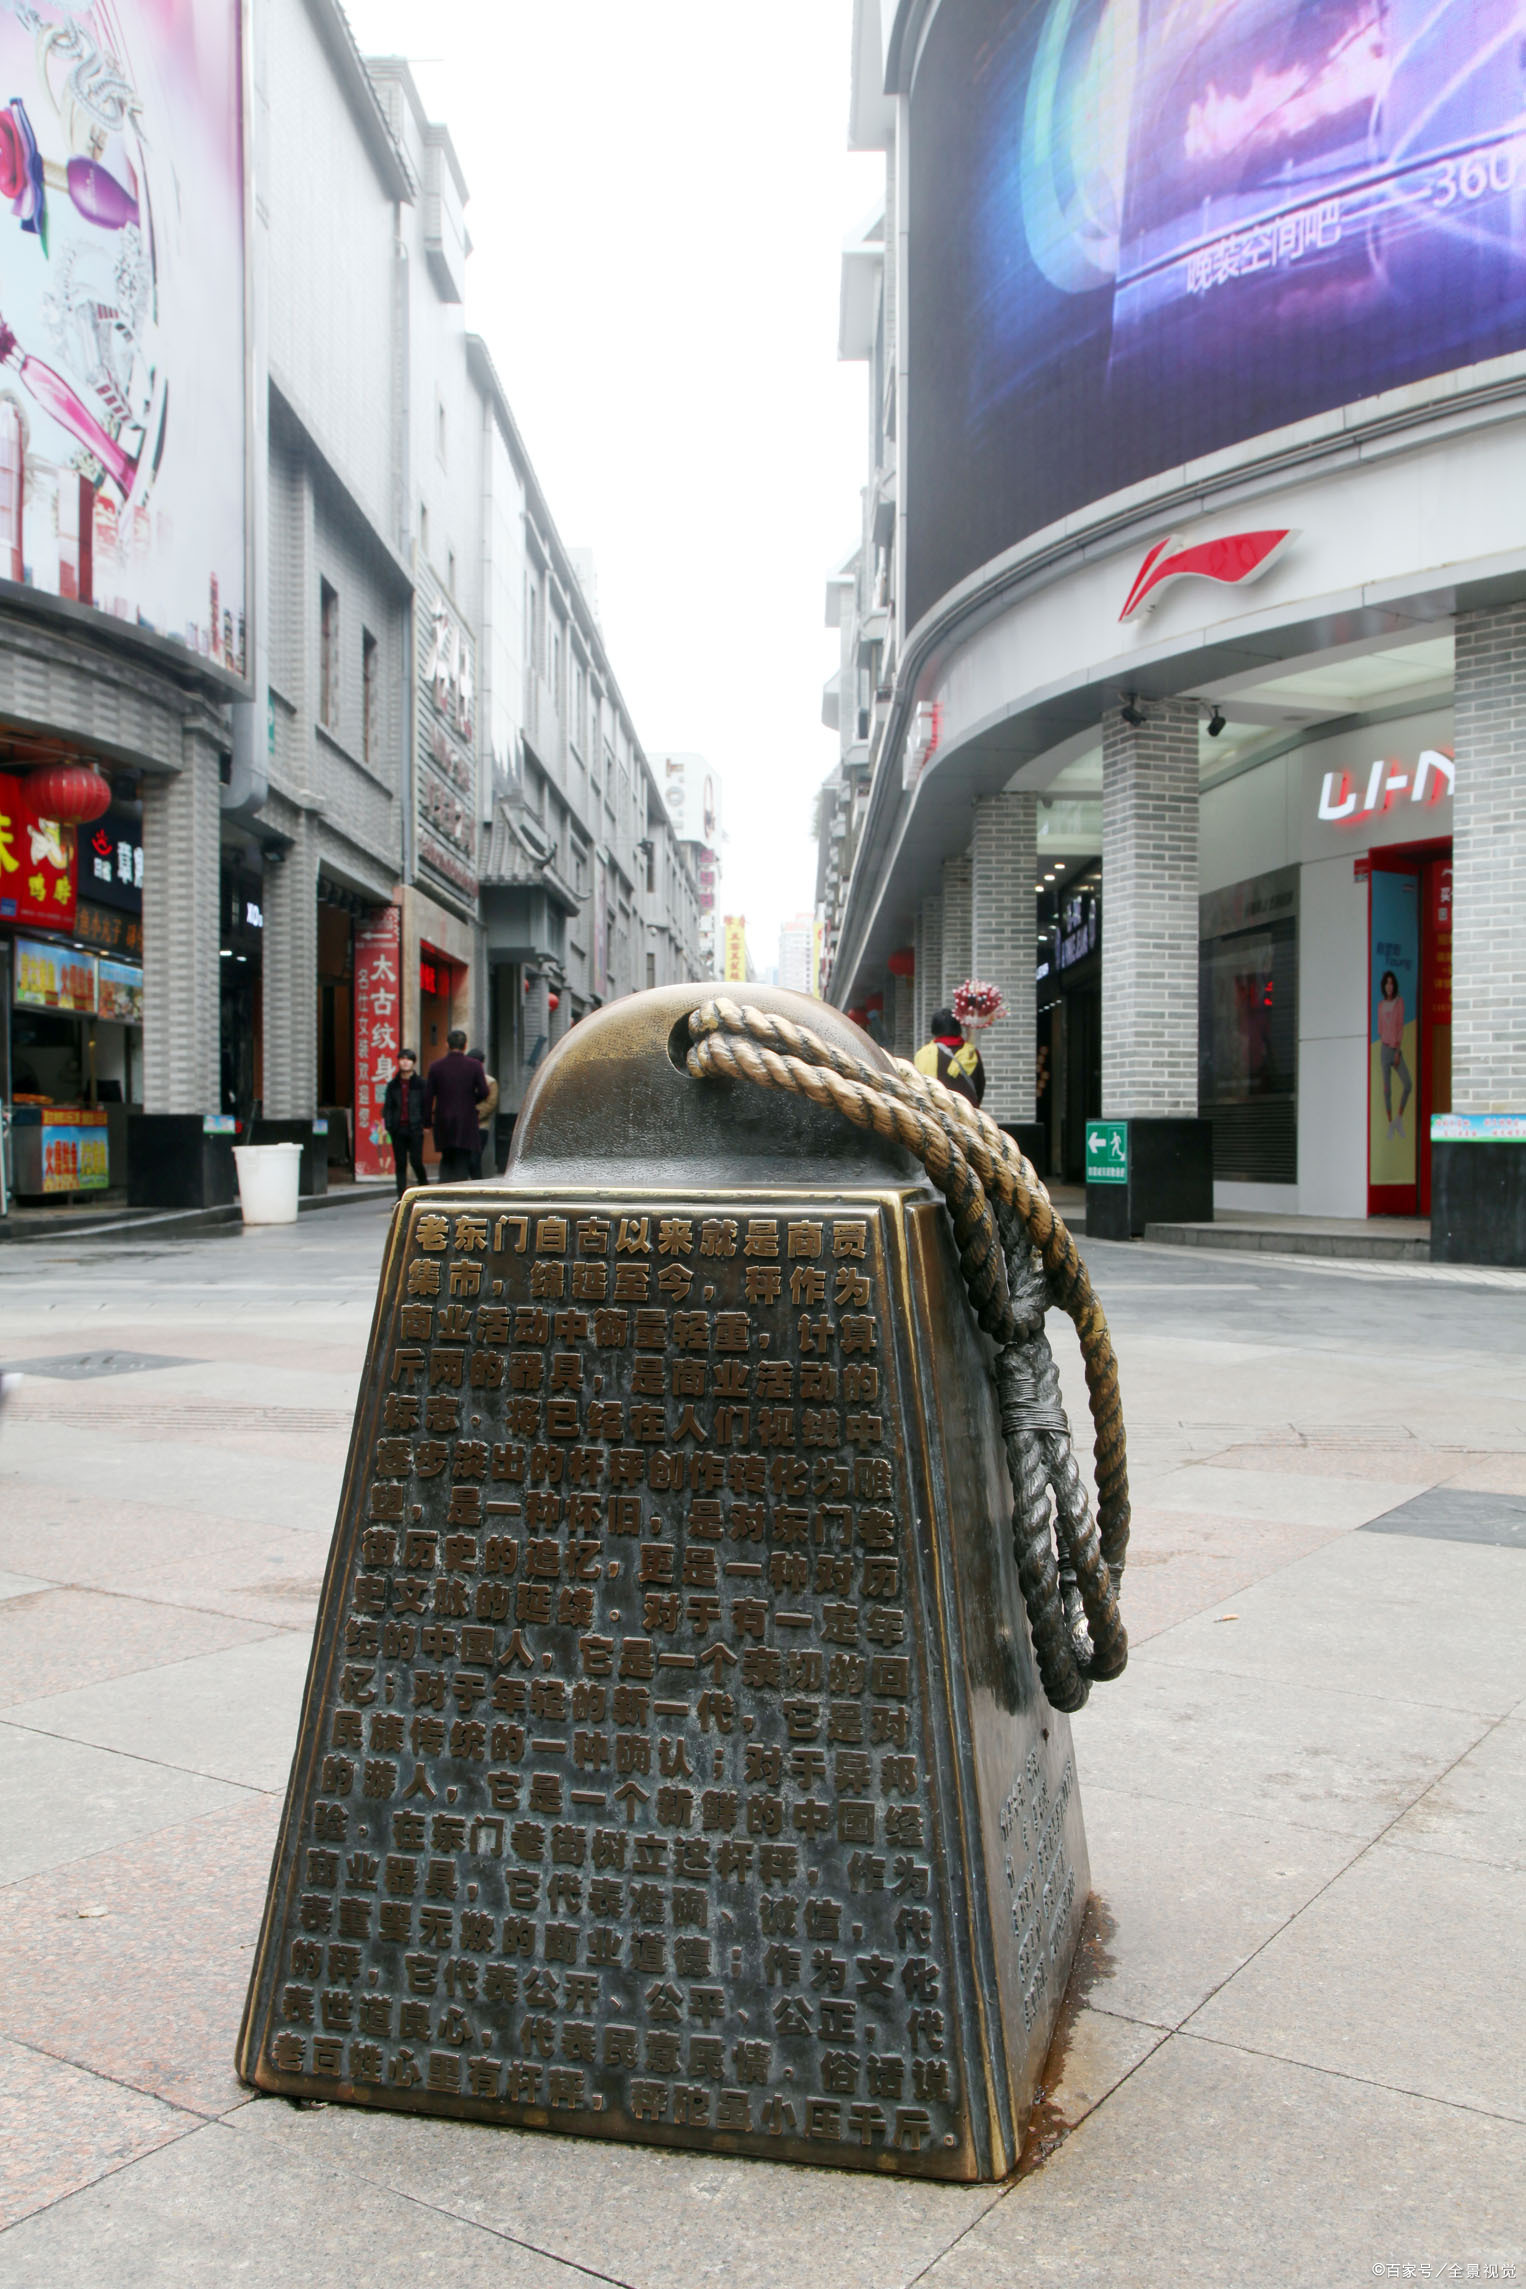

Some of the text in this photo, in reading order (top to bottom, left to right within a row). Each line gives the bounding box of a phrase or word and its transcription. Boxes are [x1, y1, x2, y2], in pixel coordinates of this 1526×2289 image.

[416, 1214, 867, 1258] 老东门自古以来就是商贾
[377, 1437, 892, 1499] 逐步淡出的杆秤创作转化为雕
